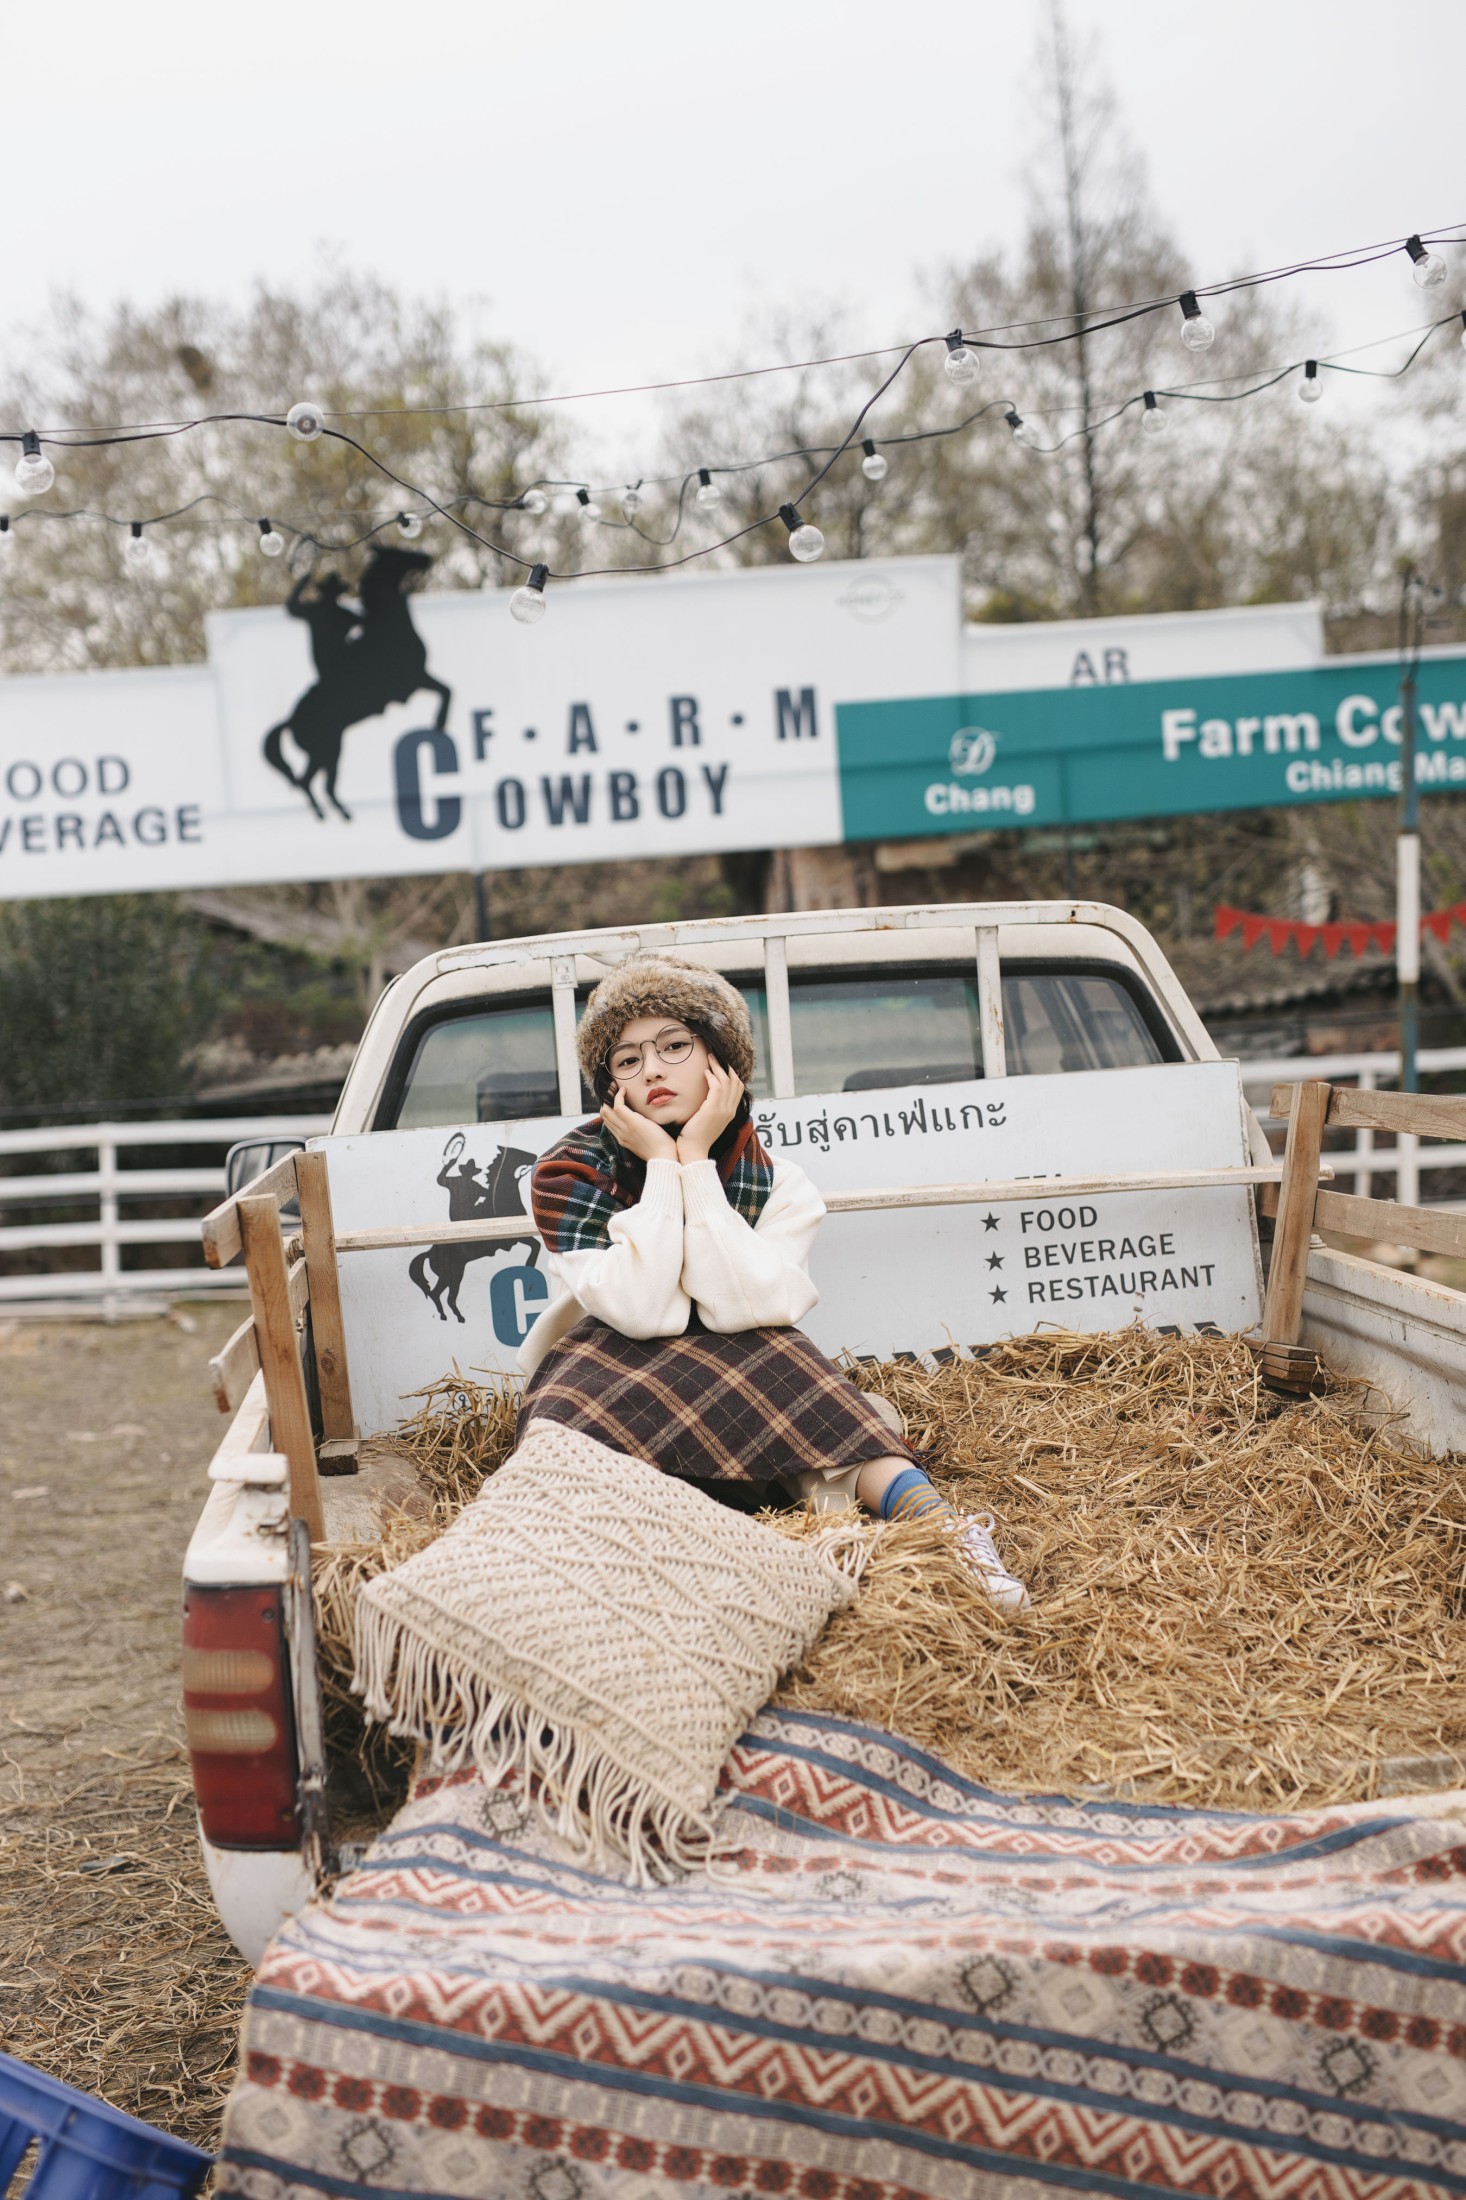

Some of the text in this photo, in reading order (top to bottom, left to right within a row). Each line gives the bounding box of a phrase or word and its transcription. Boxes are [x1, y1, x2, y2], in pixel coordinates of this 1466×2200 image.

[1161, 707, 1321, 762] Farm
[1285, 757, 1404, 793] Chiang
[924, 782, 1035, 816] Chang
[1020, 1206, 1098, 1233] FOOD
[1024, 1233, 1176, 1269] BEVERAGE
[1028, 1264, 1215, 1304] RESTAURANT
